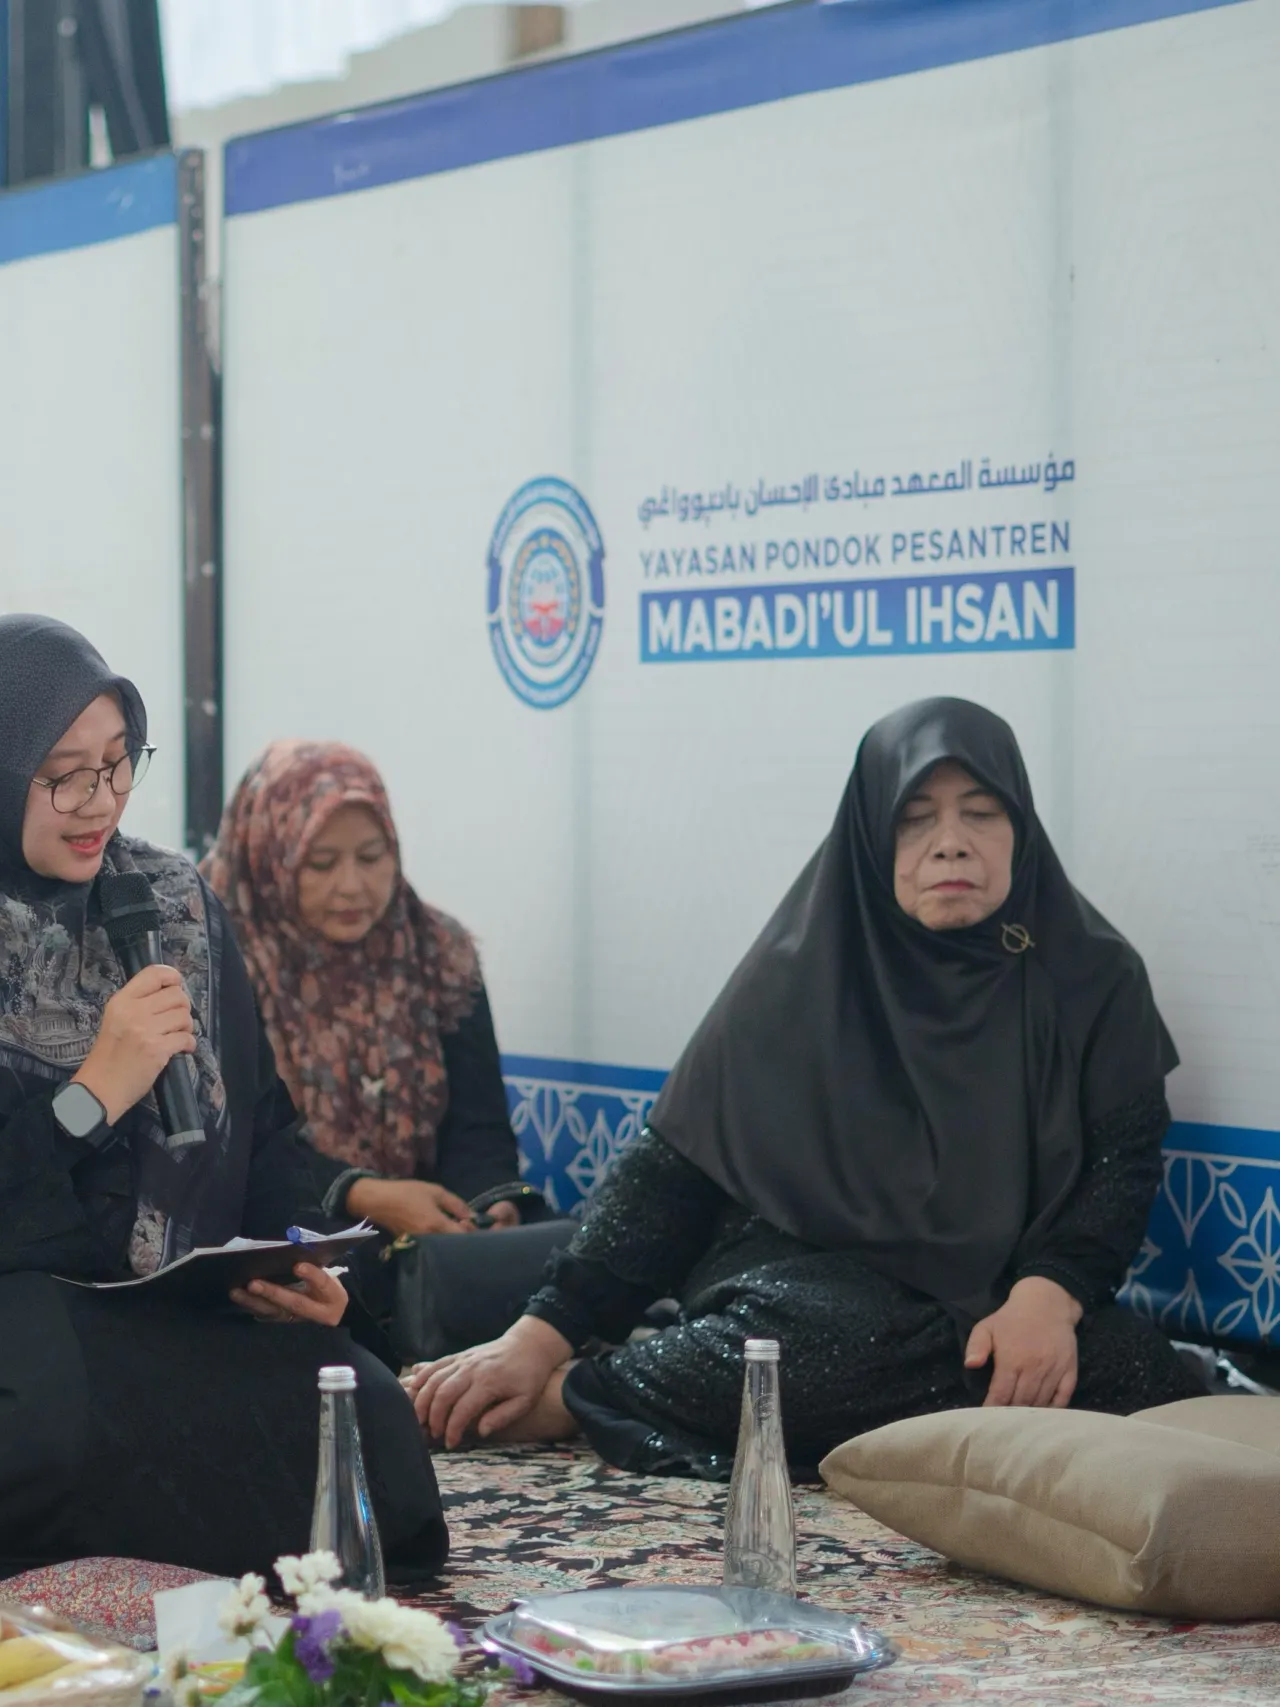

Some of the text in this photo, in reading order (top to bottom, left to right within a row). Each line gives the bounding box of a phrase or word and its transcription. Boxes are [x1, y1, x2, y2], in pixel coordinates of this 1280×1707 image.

[891, 460, 972, 496] المعهد
[978, 452, 1075, 492] مؤسسة
[639, 521, 1070, 578] YAYASAN PONDOK PESANTREN
[648, 579, 1059, 654] MABADI'UL IHSAN
